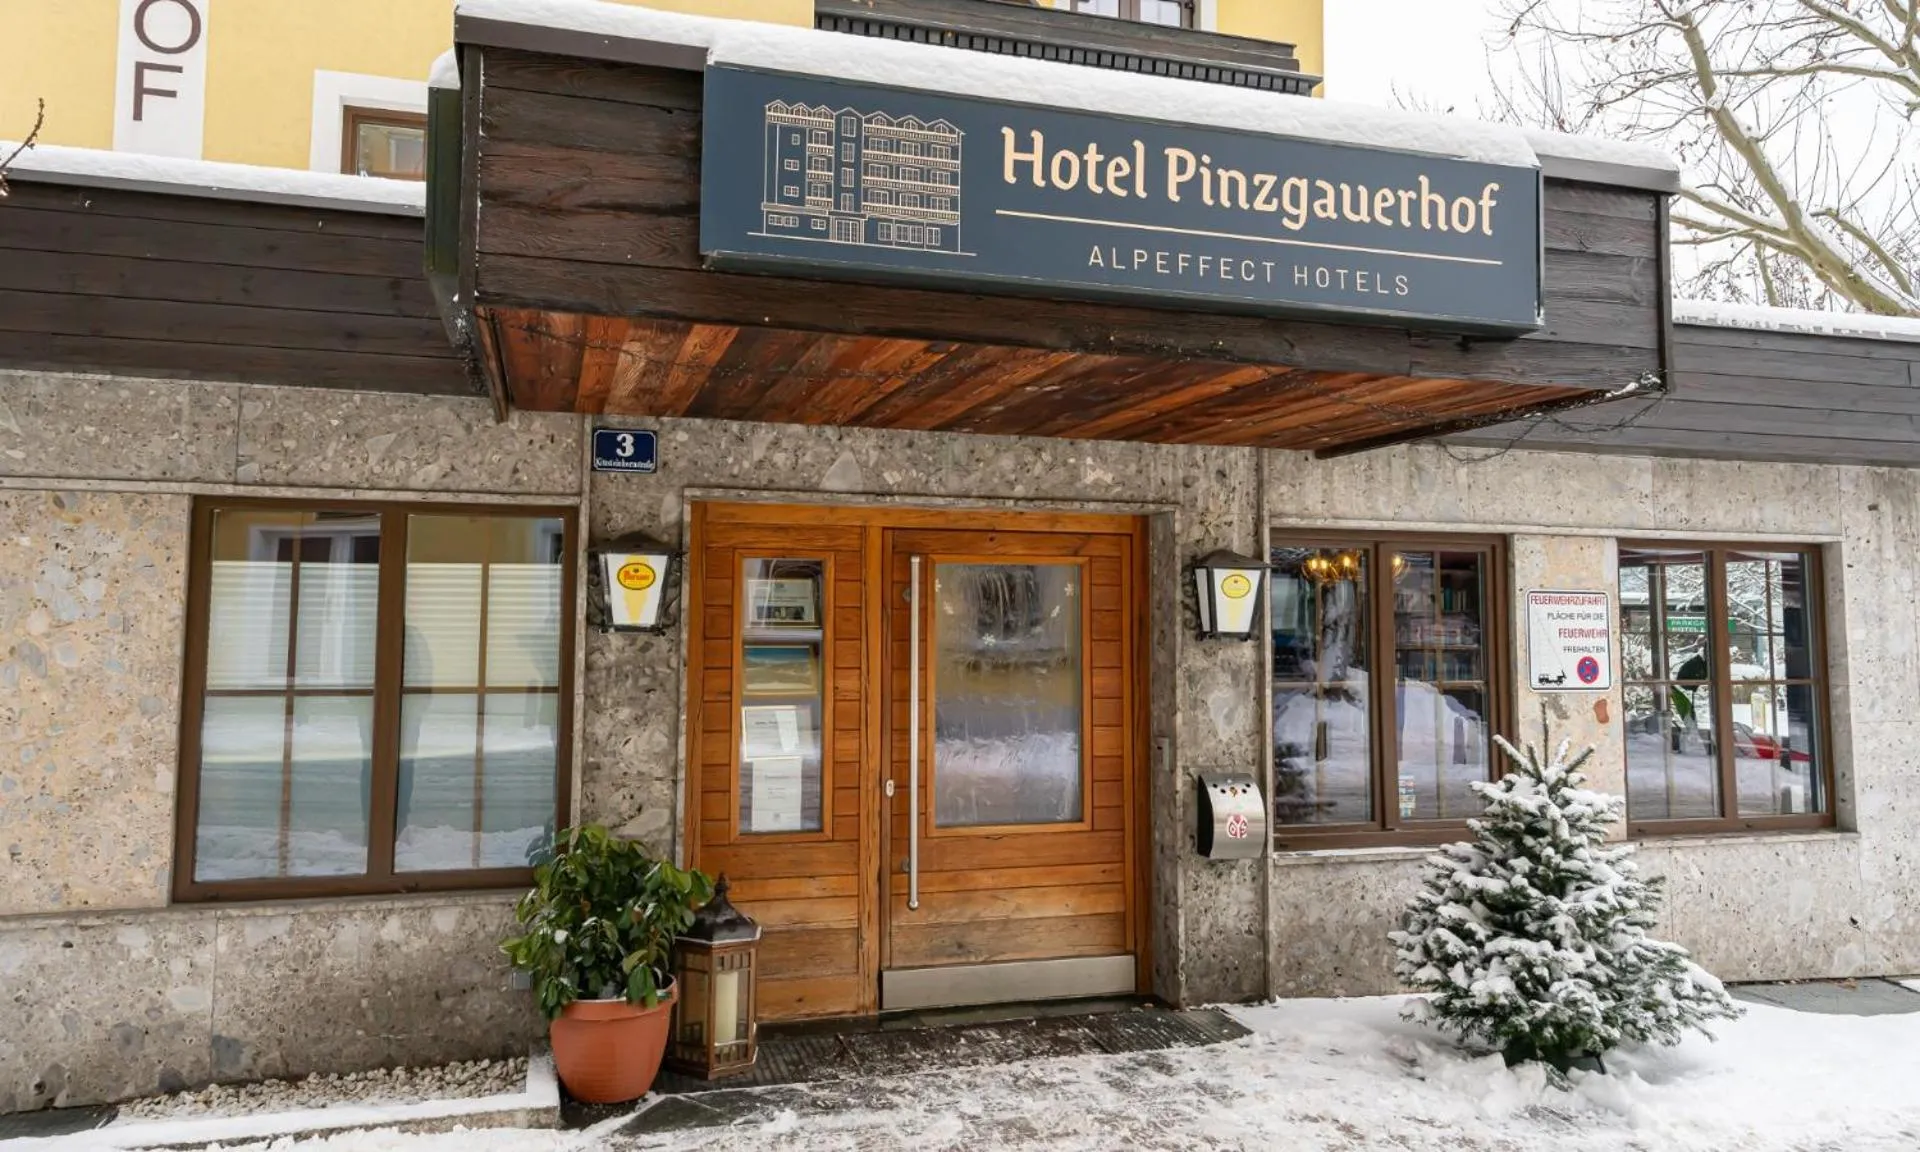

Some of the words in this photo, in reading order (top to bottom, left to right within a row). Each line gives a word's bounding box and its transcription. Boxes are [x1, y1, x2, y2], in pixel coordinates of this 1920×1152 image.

[133, 0, 202, 122] OF
[1001, 126, 1148, 199] Hotel
[1163, 147, 1500, 237] Pinzgauerhof
[1088, 245, 1276, 284] ALPEFFECT
[1293, 264, 1410, 297] HOTELS
[616, 433, 635, 458] 3
[1530, 595, 1606, 606] FEUERWEHRZUFAHRT
[1558, 627, 1609, 639] FEUERWEHR
[1562, 645, 1606, 654] FREIHALTEN
